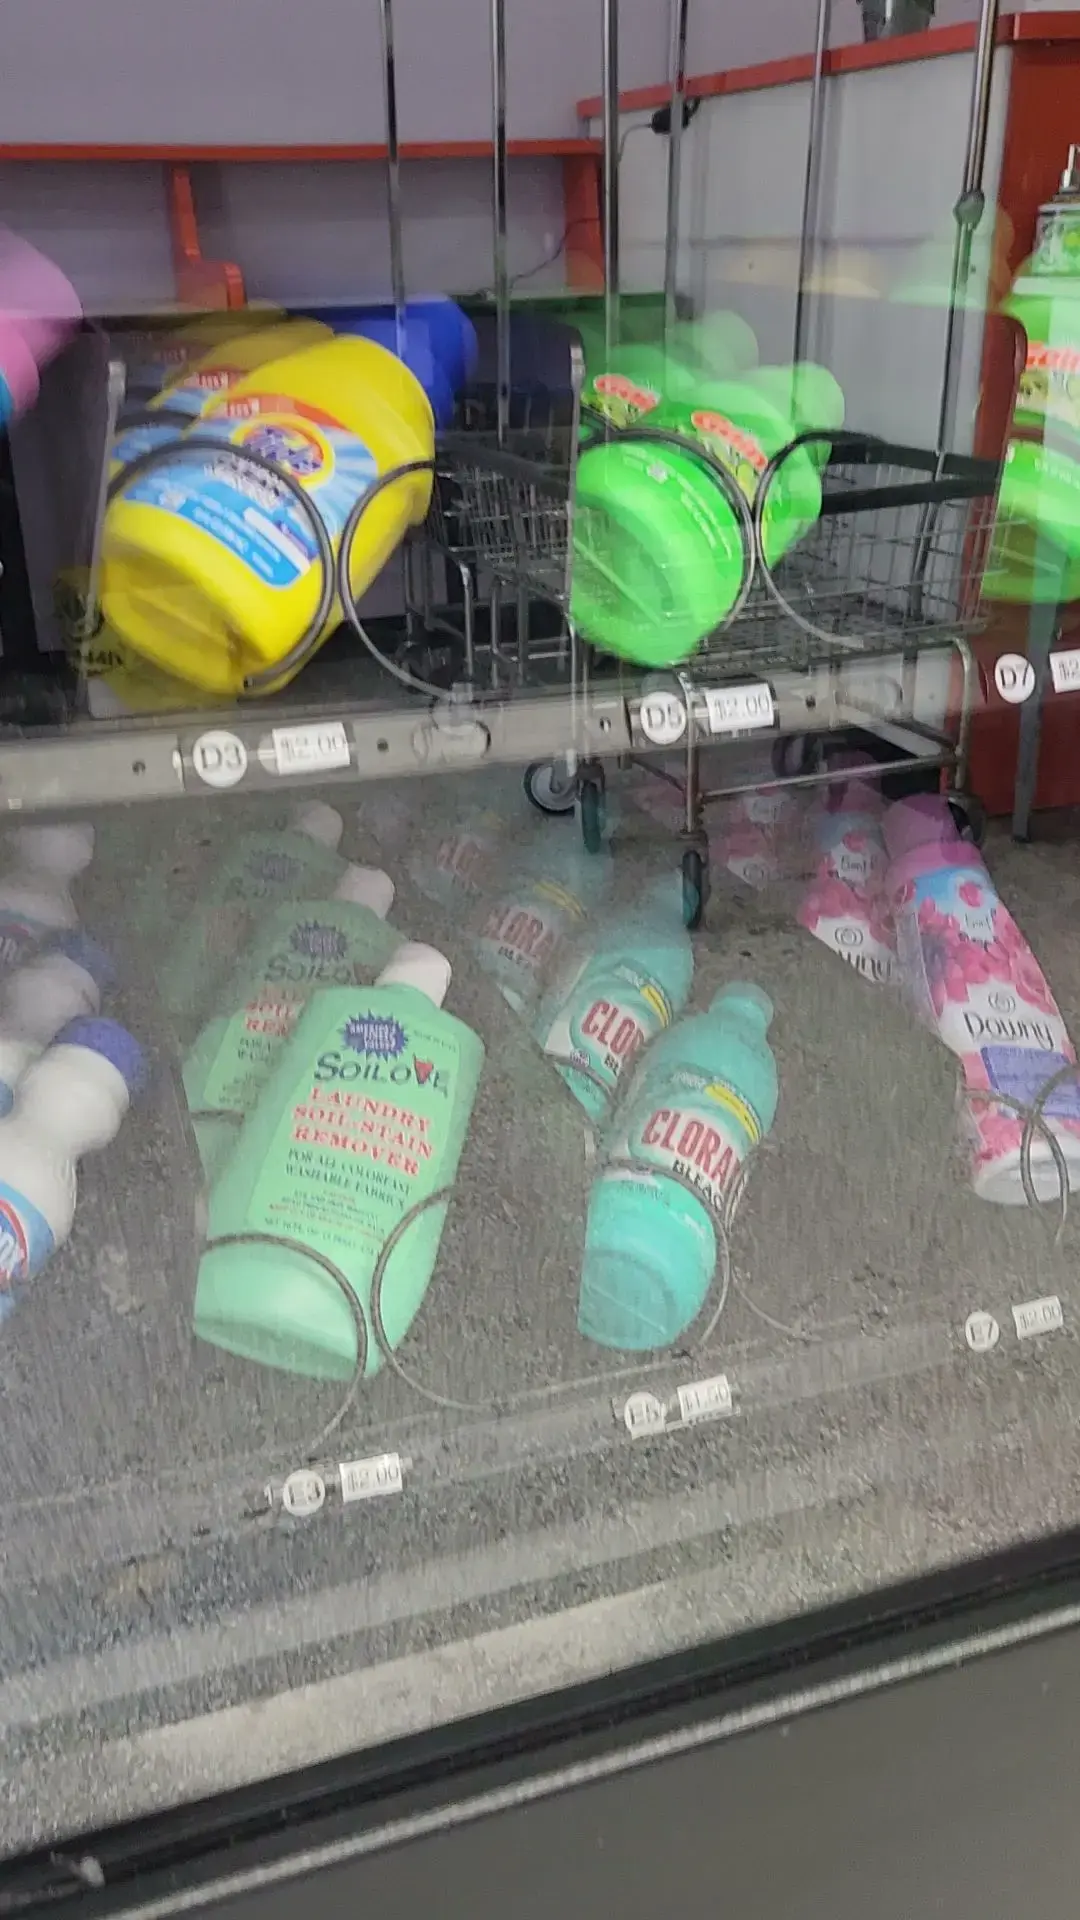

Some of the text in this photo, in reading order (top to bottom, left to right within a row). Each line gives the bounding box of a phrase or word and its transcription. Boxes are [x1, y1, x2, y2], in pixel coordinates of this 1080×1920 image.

[1000, 661, 1029, 689] D7
[714, 692, 770, 722] $2.00
[200, 732, 347, 770] D3 $2.00
[963, 1010, 1055, 1052] Downy
[311, 1086, 431, 1134] LAUNDRY
[288, 1148, 313, 1164] FOR
[319, 1154, 336, 1169] ALL
[293, 1127, 420, 1176] REMOVER
[285, 1163, 350, 1189] WASHABLE
[355, 1181, 405, 1211] FABRICS
[672, 1159, 725, 1212] BLEAC
[347, 1464, 400, 1493] $2.00
